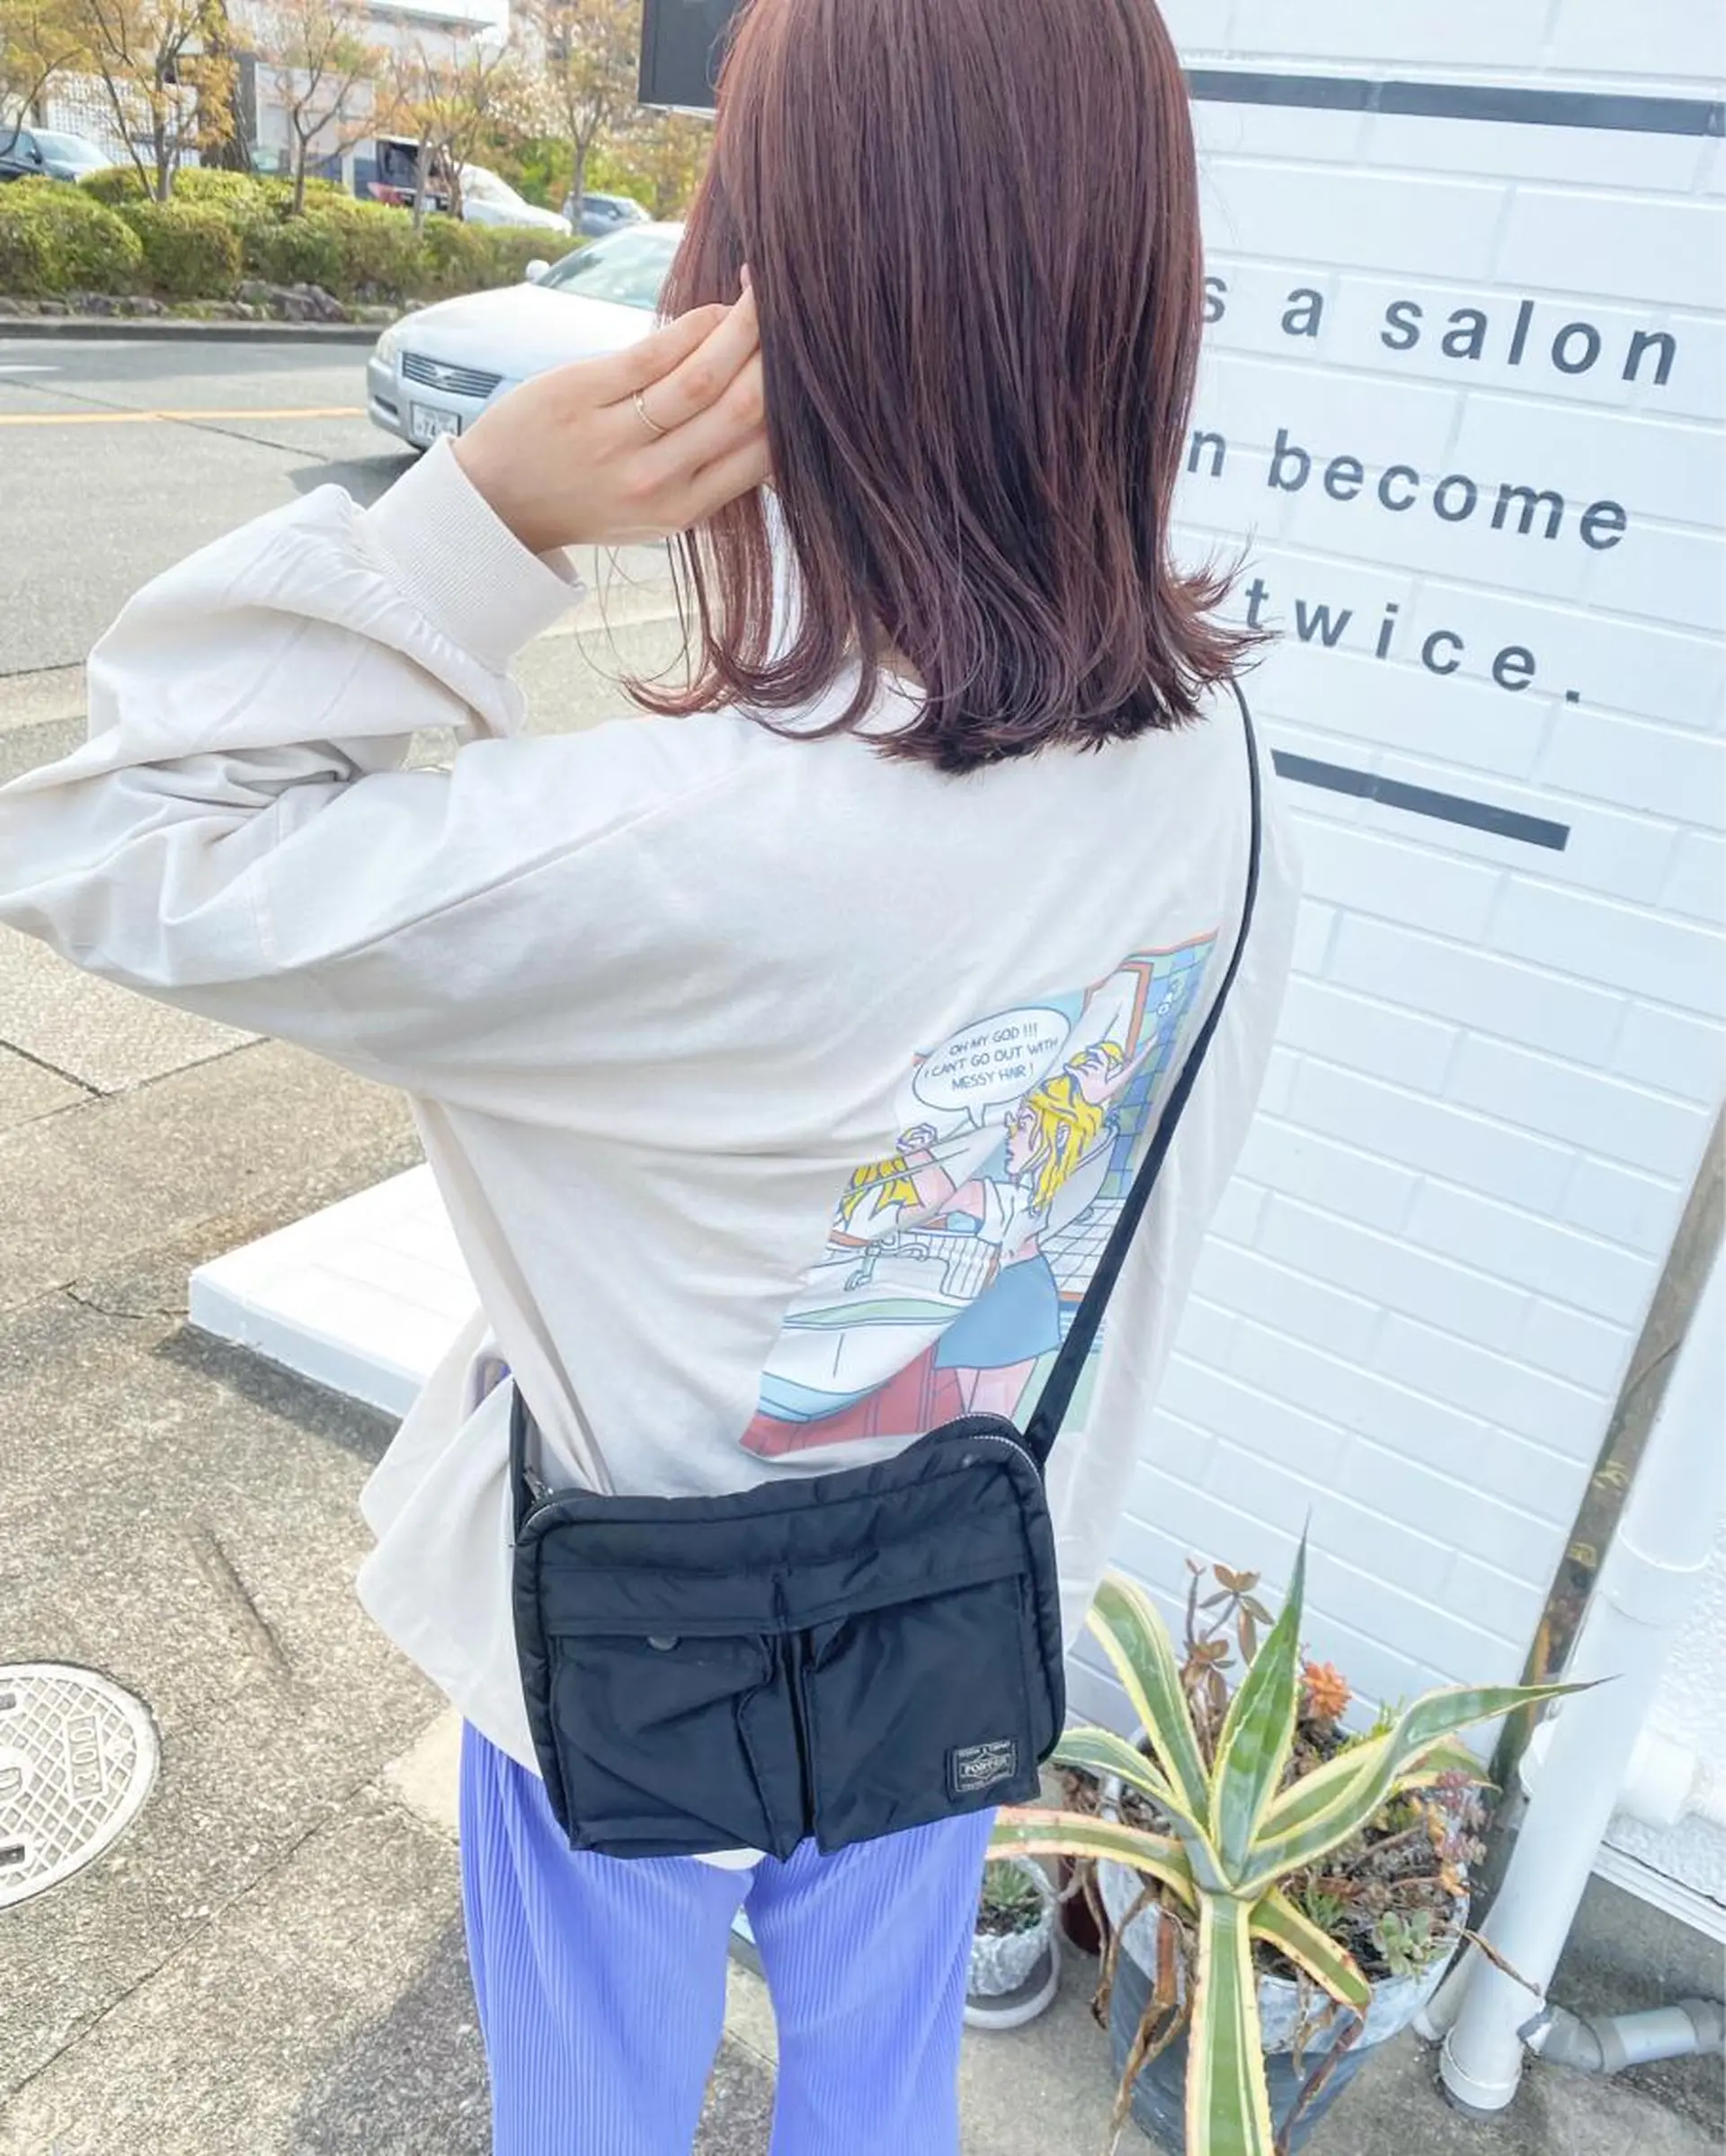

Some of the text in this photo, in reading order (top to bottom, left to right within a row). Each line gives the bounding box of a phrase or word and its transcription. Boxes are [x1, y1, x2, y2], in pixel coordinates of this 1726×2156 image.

[1281, 288, 1324, 337] a
[1380, 299, 1677, 386] salon
[1268, 429, 1627, 550] become
[1245, 578, 1580, 704] twice.
[949, 1041, 969, 1056] OH
[970, 1035, 989, 1050] MY
[970, 1052, 991, 1067] GO
[994, 1045, 1023, 1062] OUT
[1027, 1036, 1059, 1055] WITH
[952, 1070, 994, 1090] MESSY
